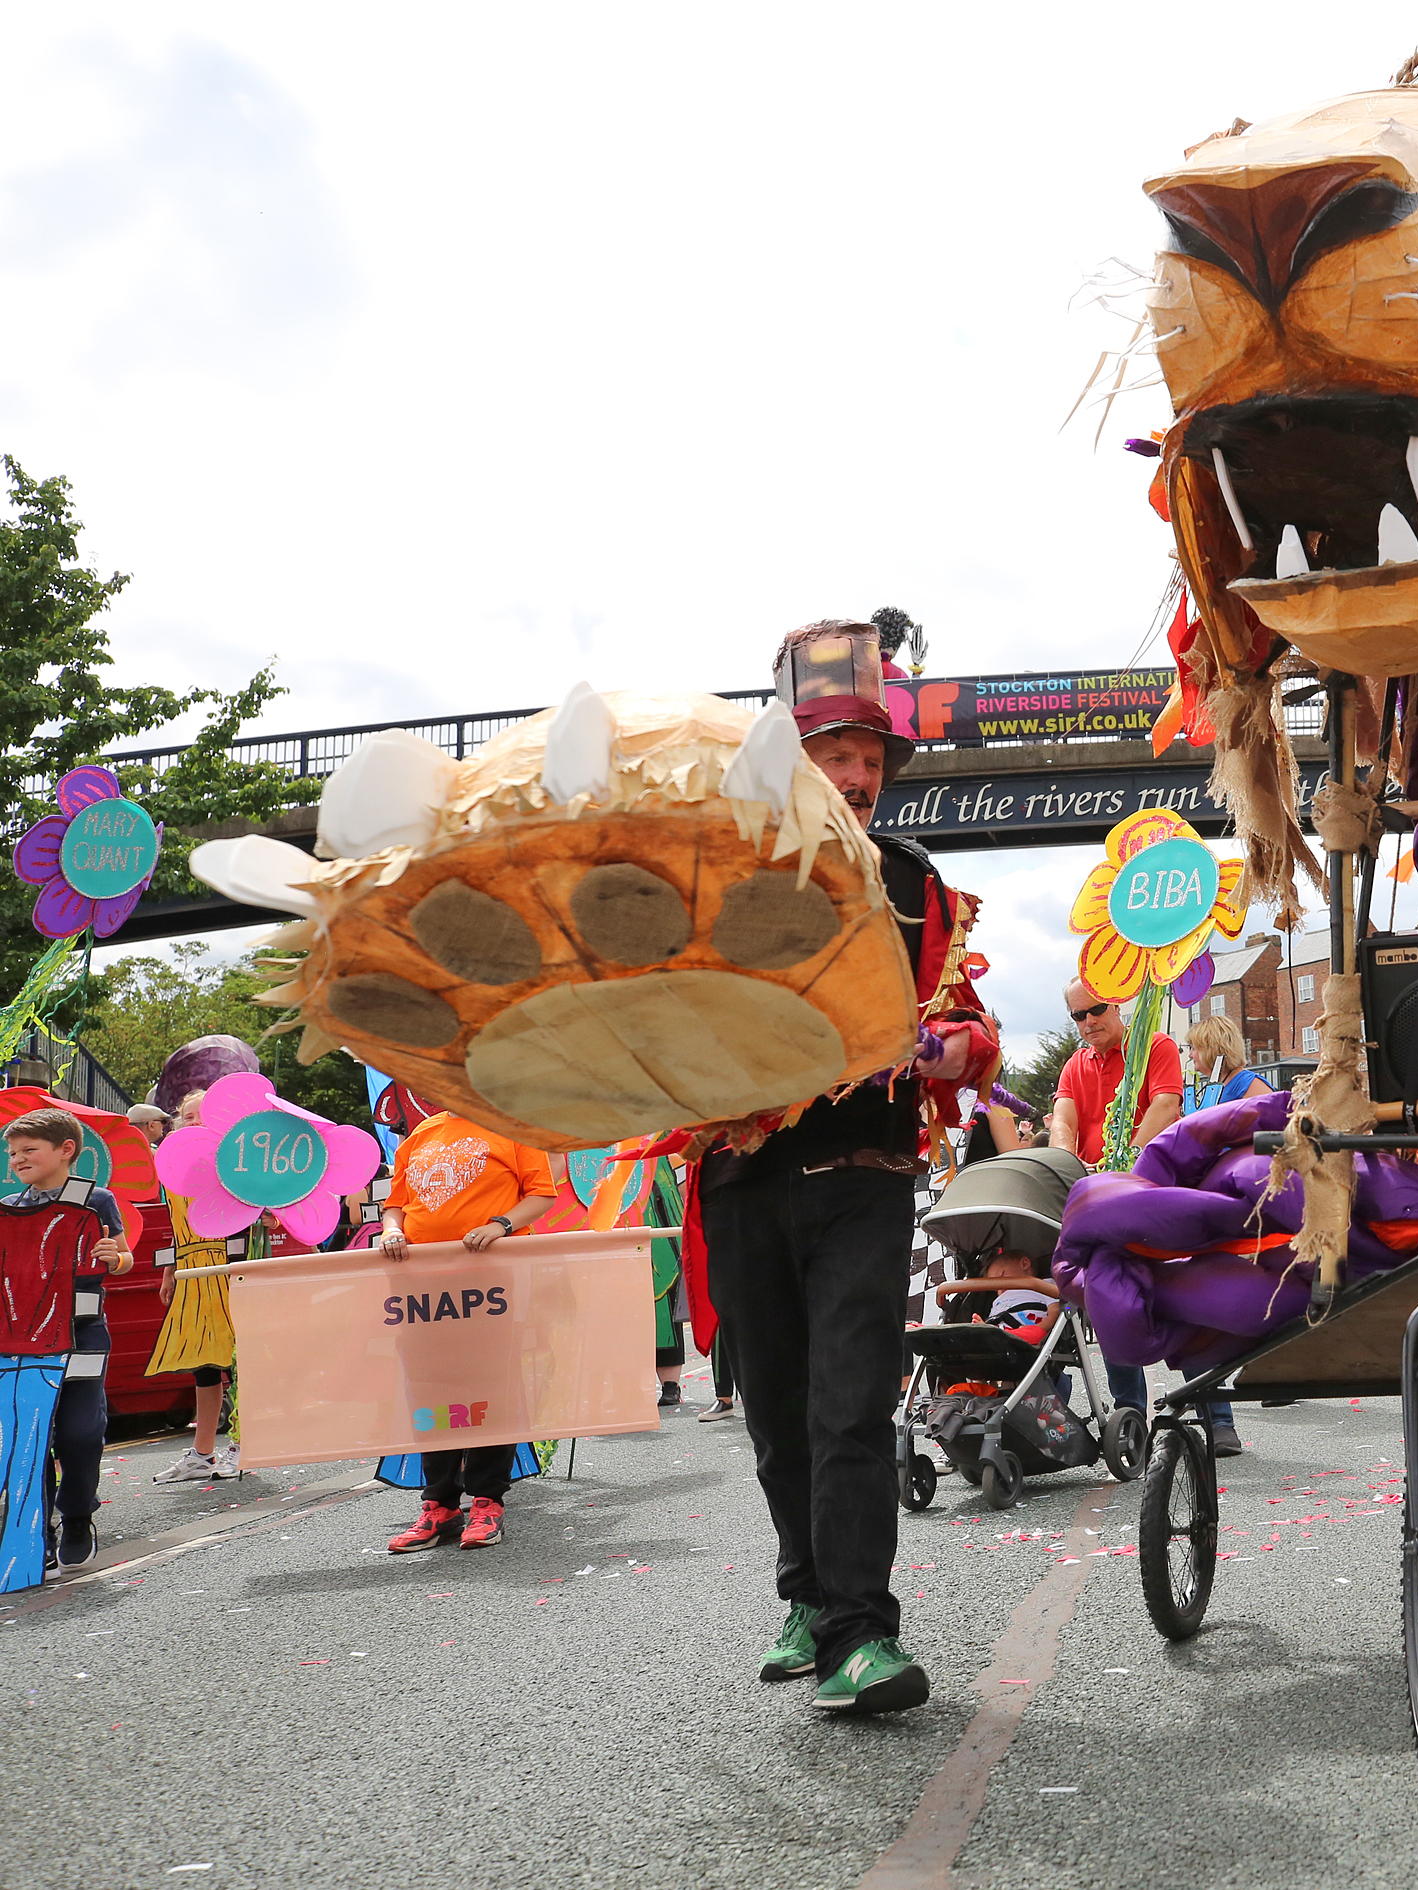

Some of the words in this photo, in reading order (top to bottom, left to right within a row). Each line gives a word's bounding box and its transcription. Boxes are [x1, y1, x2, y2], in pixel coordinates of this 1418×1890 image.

[976, 678, 1072, 696] STOCKTON
[1077, 671, 1178, 691] INTERNATI
[976, 694, 1072, 714] RIVERSIDE
[1077, 690, 1162, 709] FESTIVAL
[978, 709, 1153, 737] www.sirf.co.uk
[957, 784, 1014, 823] the
[1025, 784, 1124, 819] rivers
[1137, 786, 1202, 812] run
[83, 811, 142, 838] MARY
[72, 841, 146, 873] QUANT
[1127, 867, 1202, 910] BIBA
[1377, 950, 1418, 963] mambo
[233, 1132, 314, 1175] 1960
[383, 1286, 508, 1325] SNAPS
